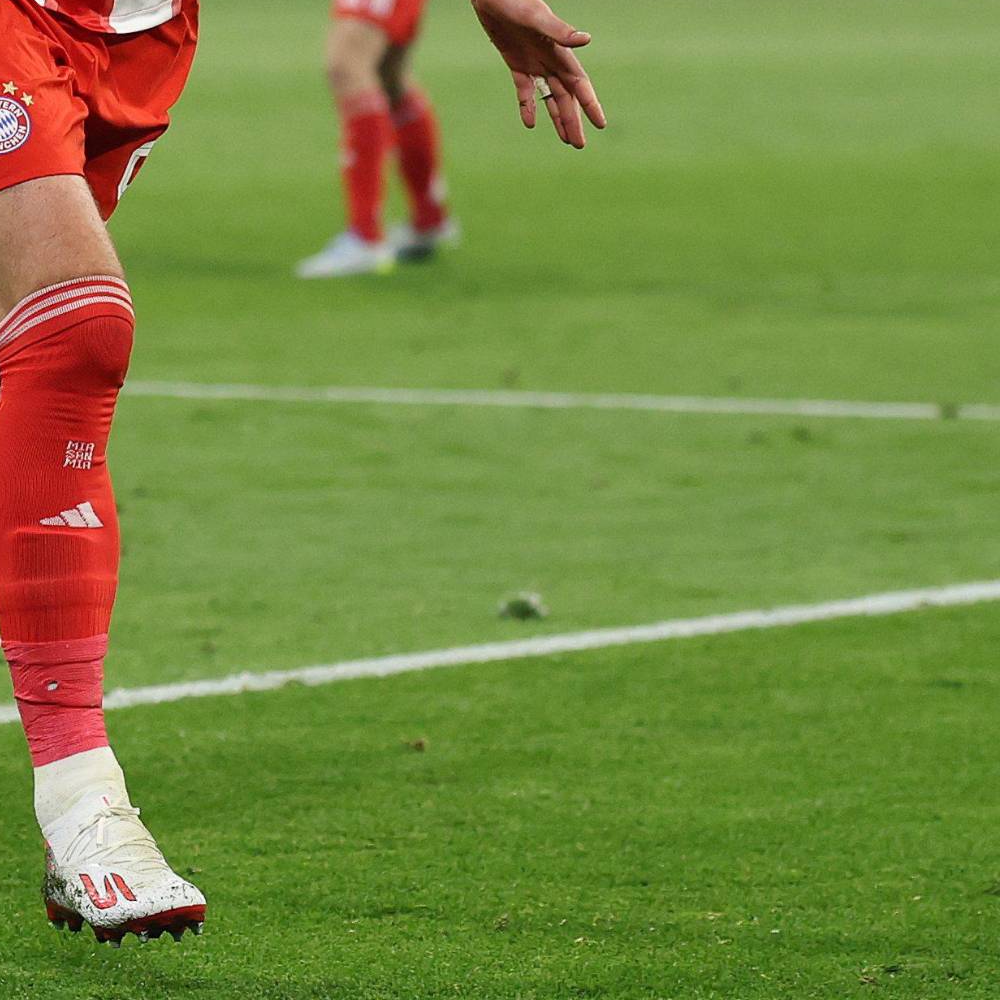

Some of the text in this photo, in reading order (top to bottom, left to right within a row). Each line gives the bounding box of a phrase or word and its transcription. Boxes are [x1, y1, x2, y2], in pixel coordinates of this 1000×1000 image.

[66, 440, 95, 451] MIA
[65, 449, 93, 461] SAN
[63, 457, 92, 470] MIA
